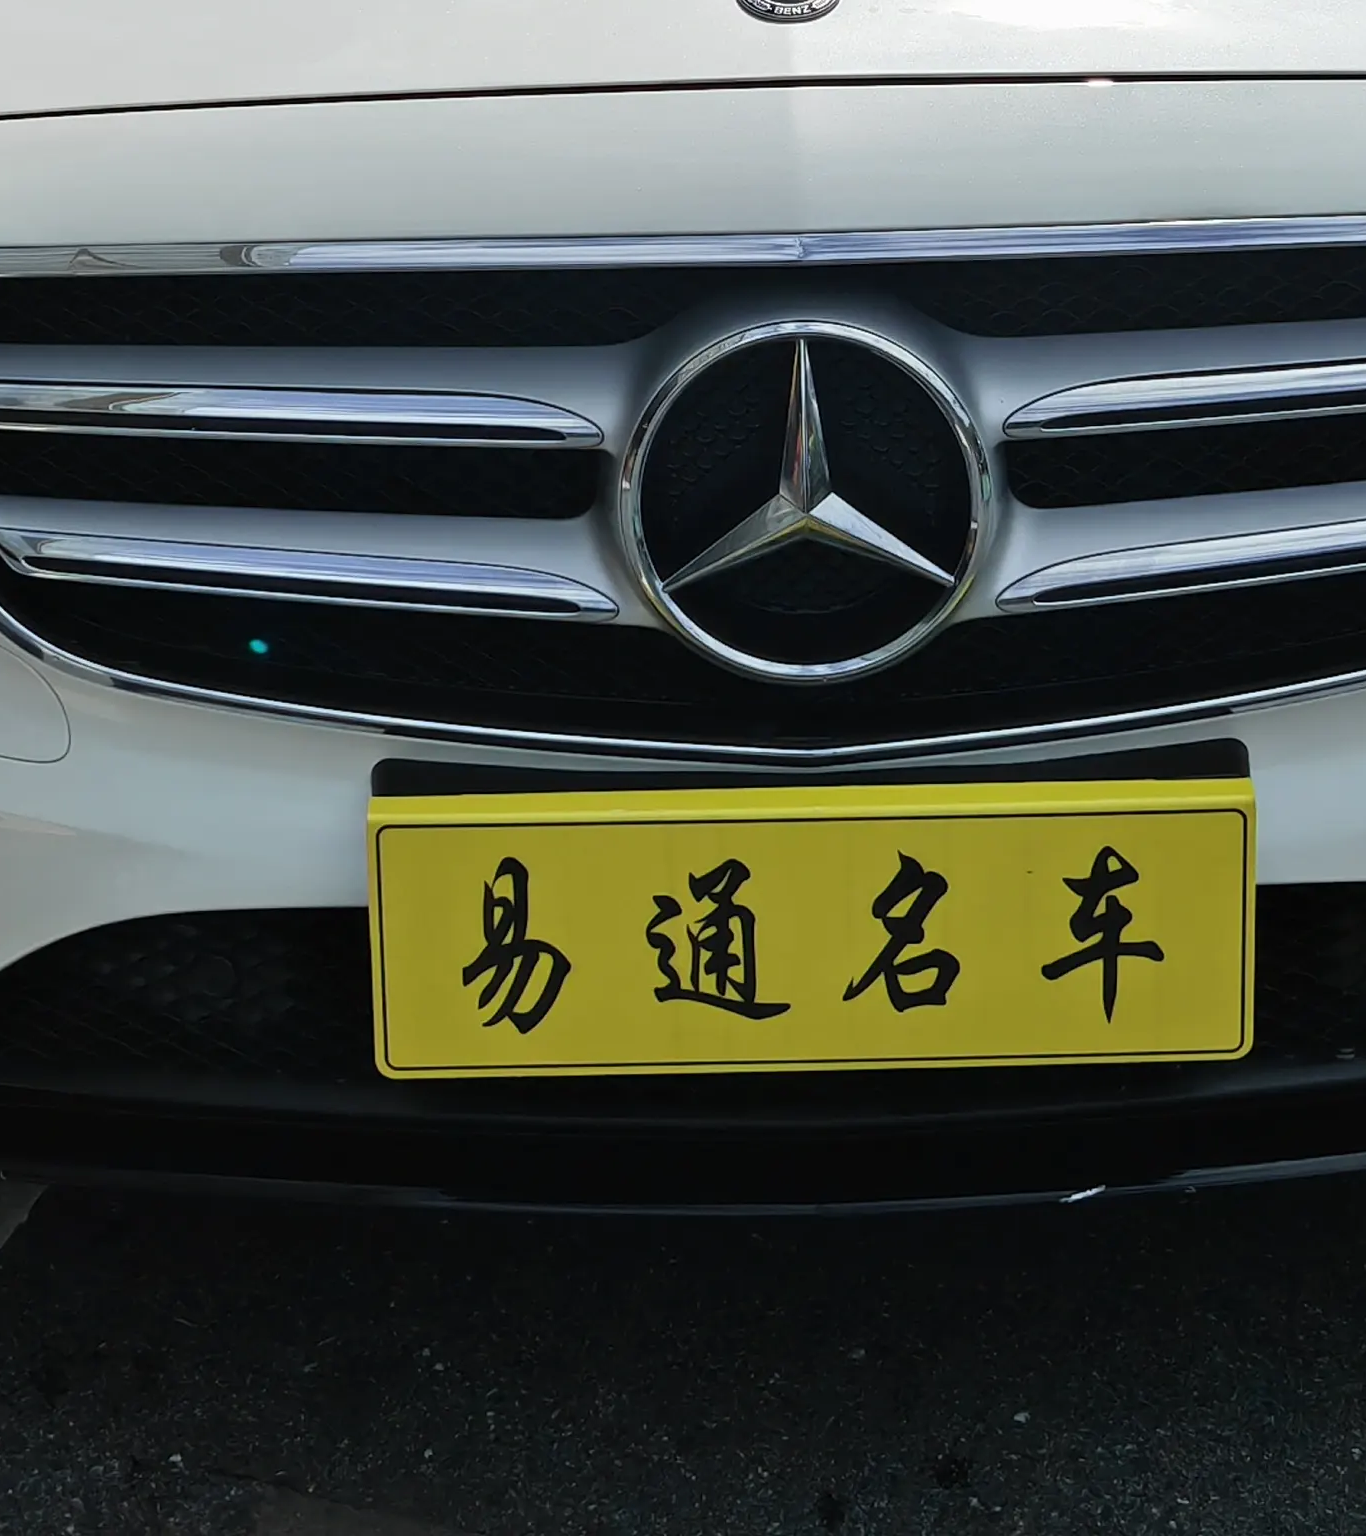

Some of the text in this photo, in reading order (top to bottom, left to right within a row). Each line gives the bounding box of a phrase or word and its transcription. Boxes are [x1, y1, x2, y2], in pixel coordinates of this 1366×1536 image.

[773, 4, 813, 16] BENZ
[461, 845, 1165, 1034] 易通名车
